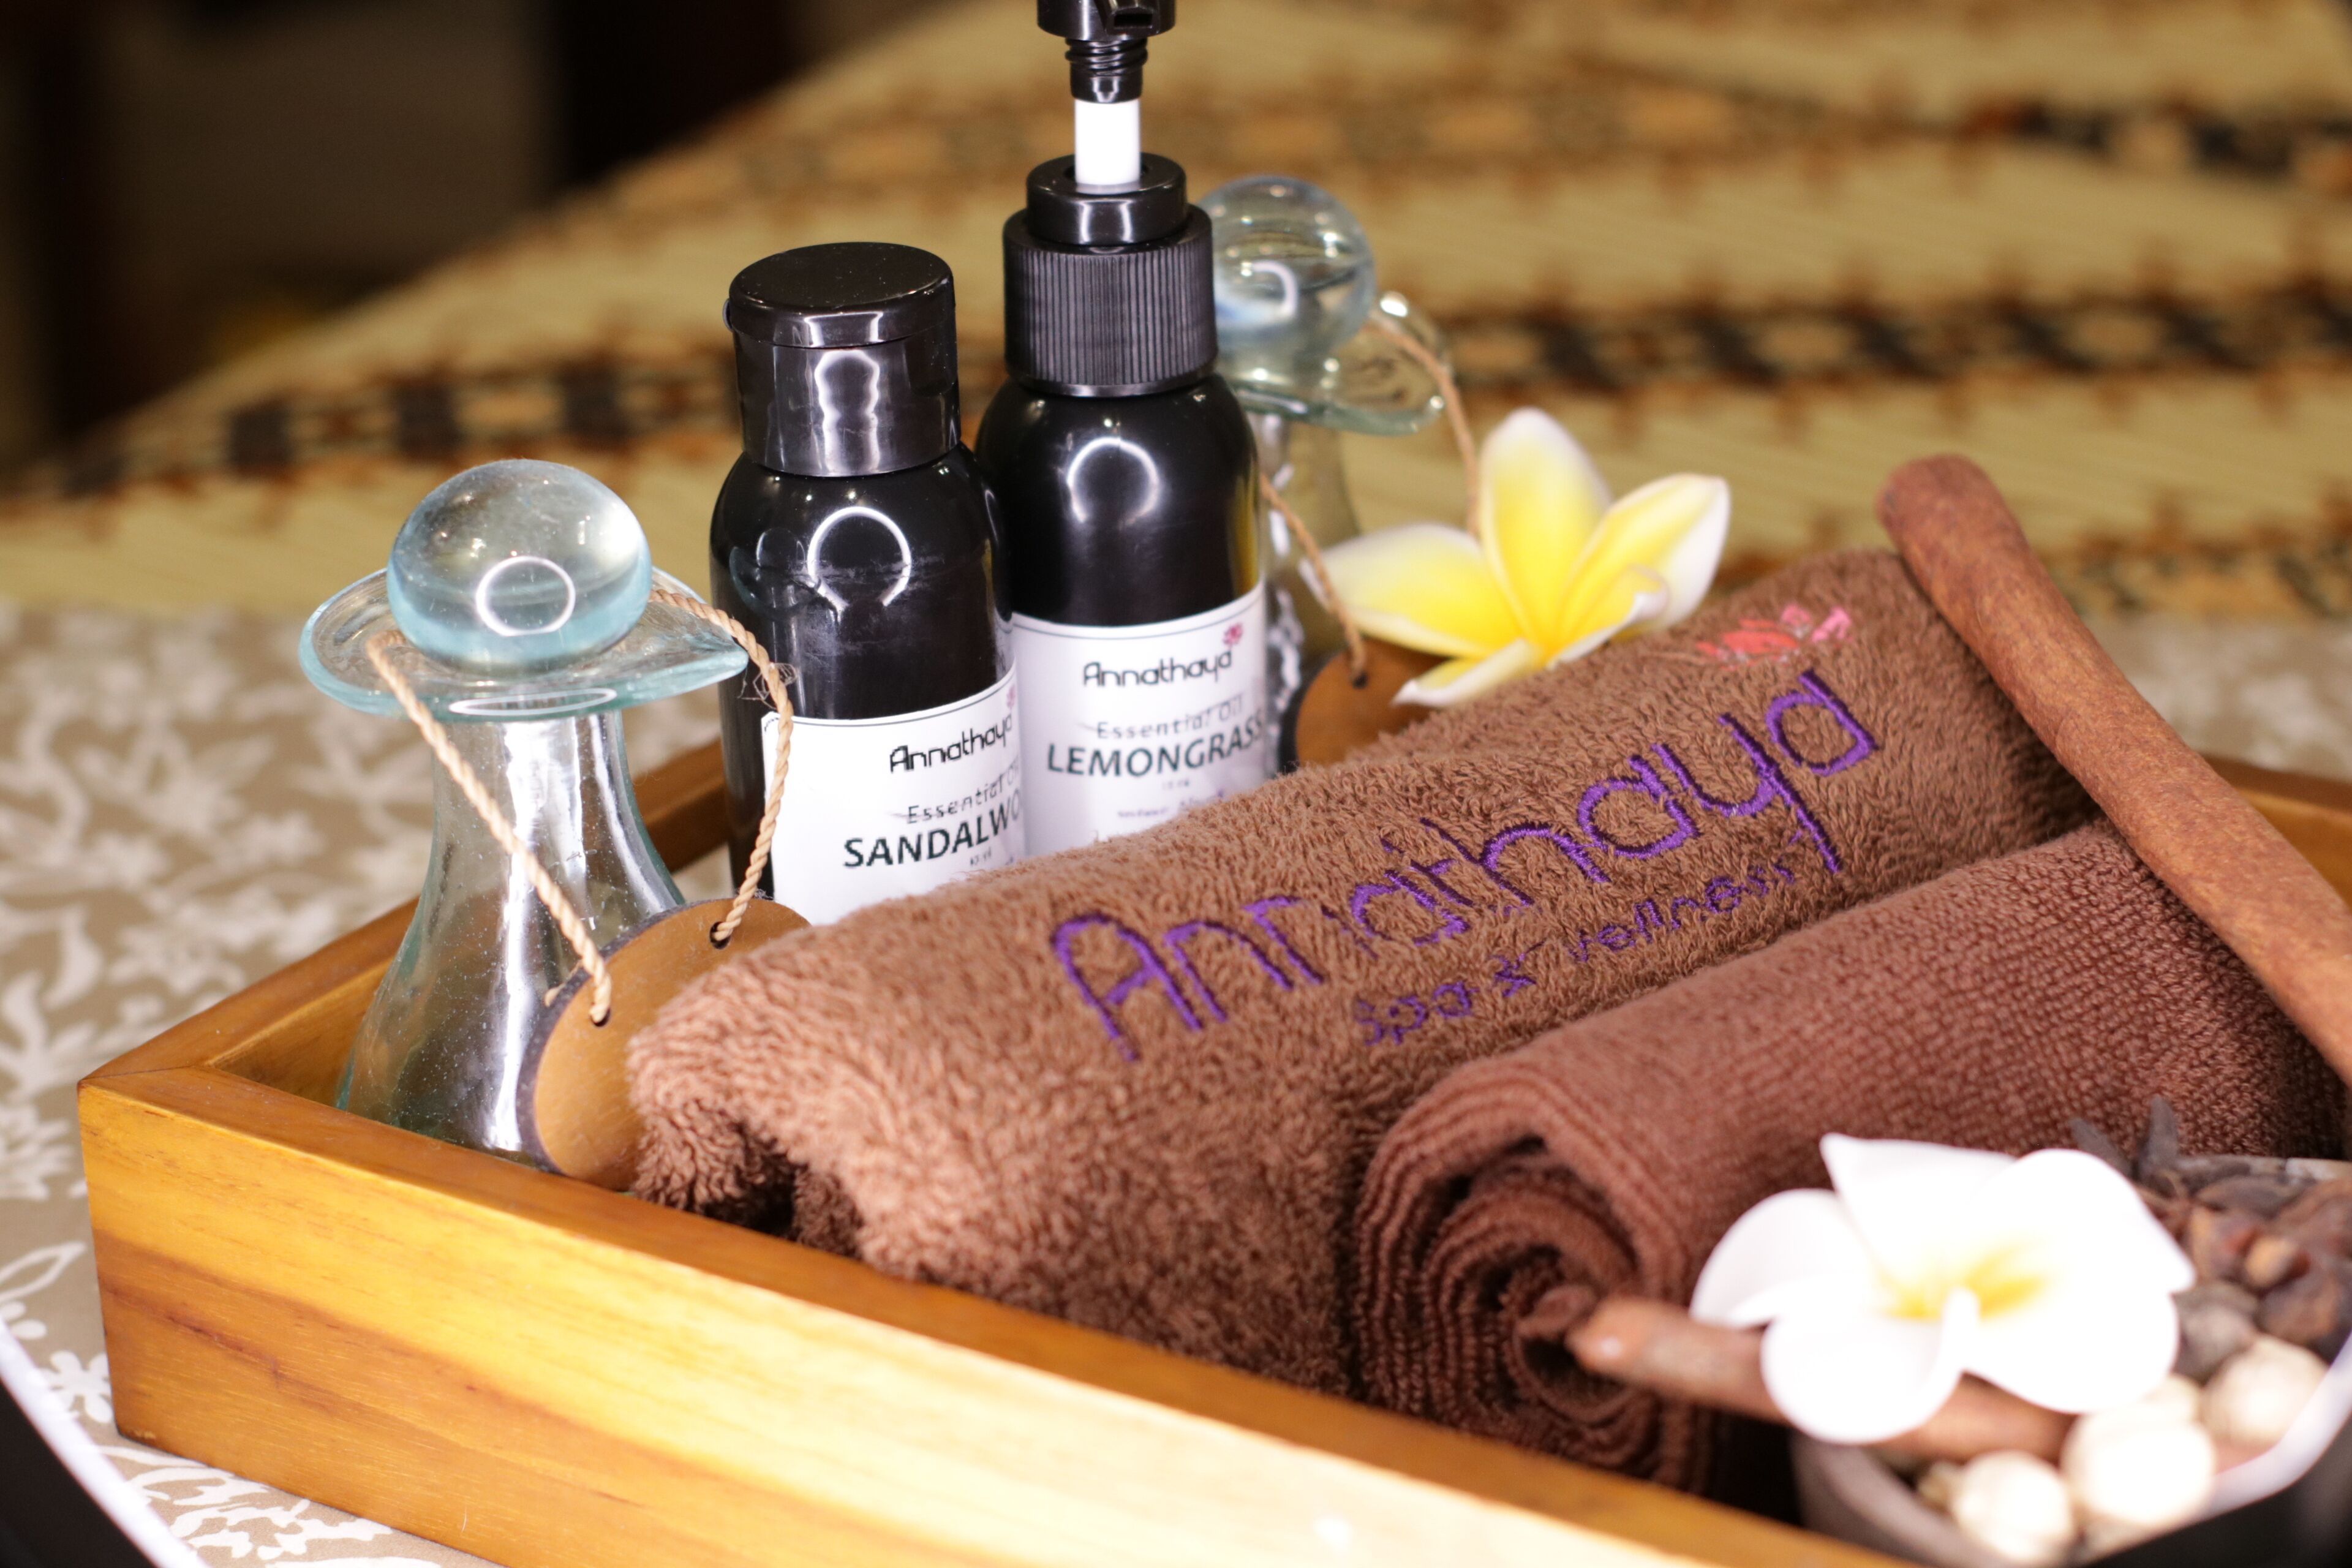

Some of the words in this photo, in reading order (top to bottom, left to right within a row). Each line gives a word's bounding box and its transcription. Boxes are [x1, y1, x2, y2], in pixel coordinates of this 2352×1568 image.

[1082, 649, 1232, 687] Annathaya
[889, 712, 1013, 774] Annathaya
[1047, 706, 1263, 777] LEMONGRASS
[1097, 706, 1210, 739] Essential
[1051, 669, 1879, 1062] Annathaya
